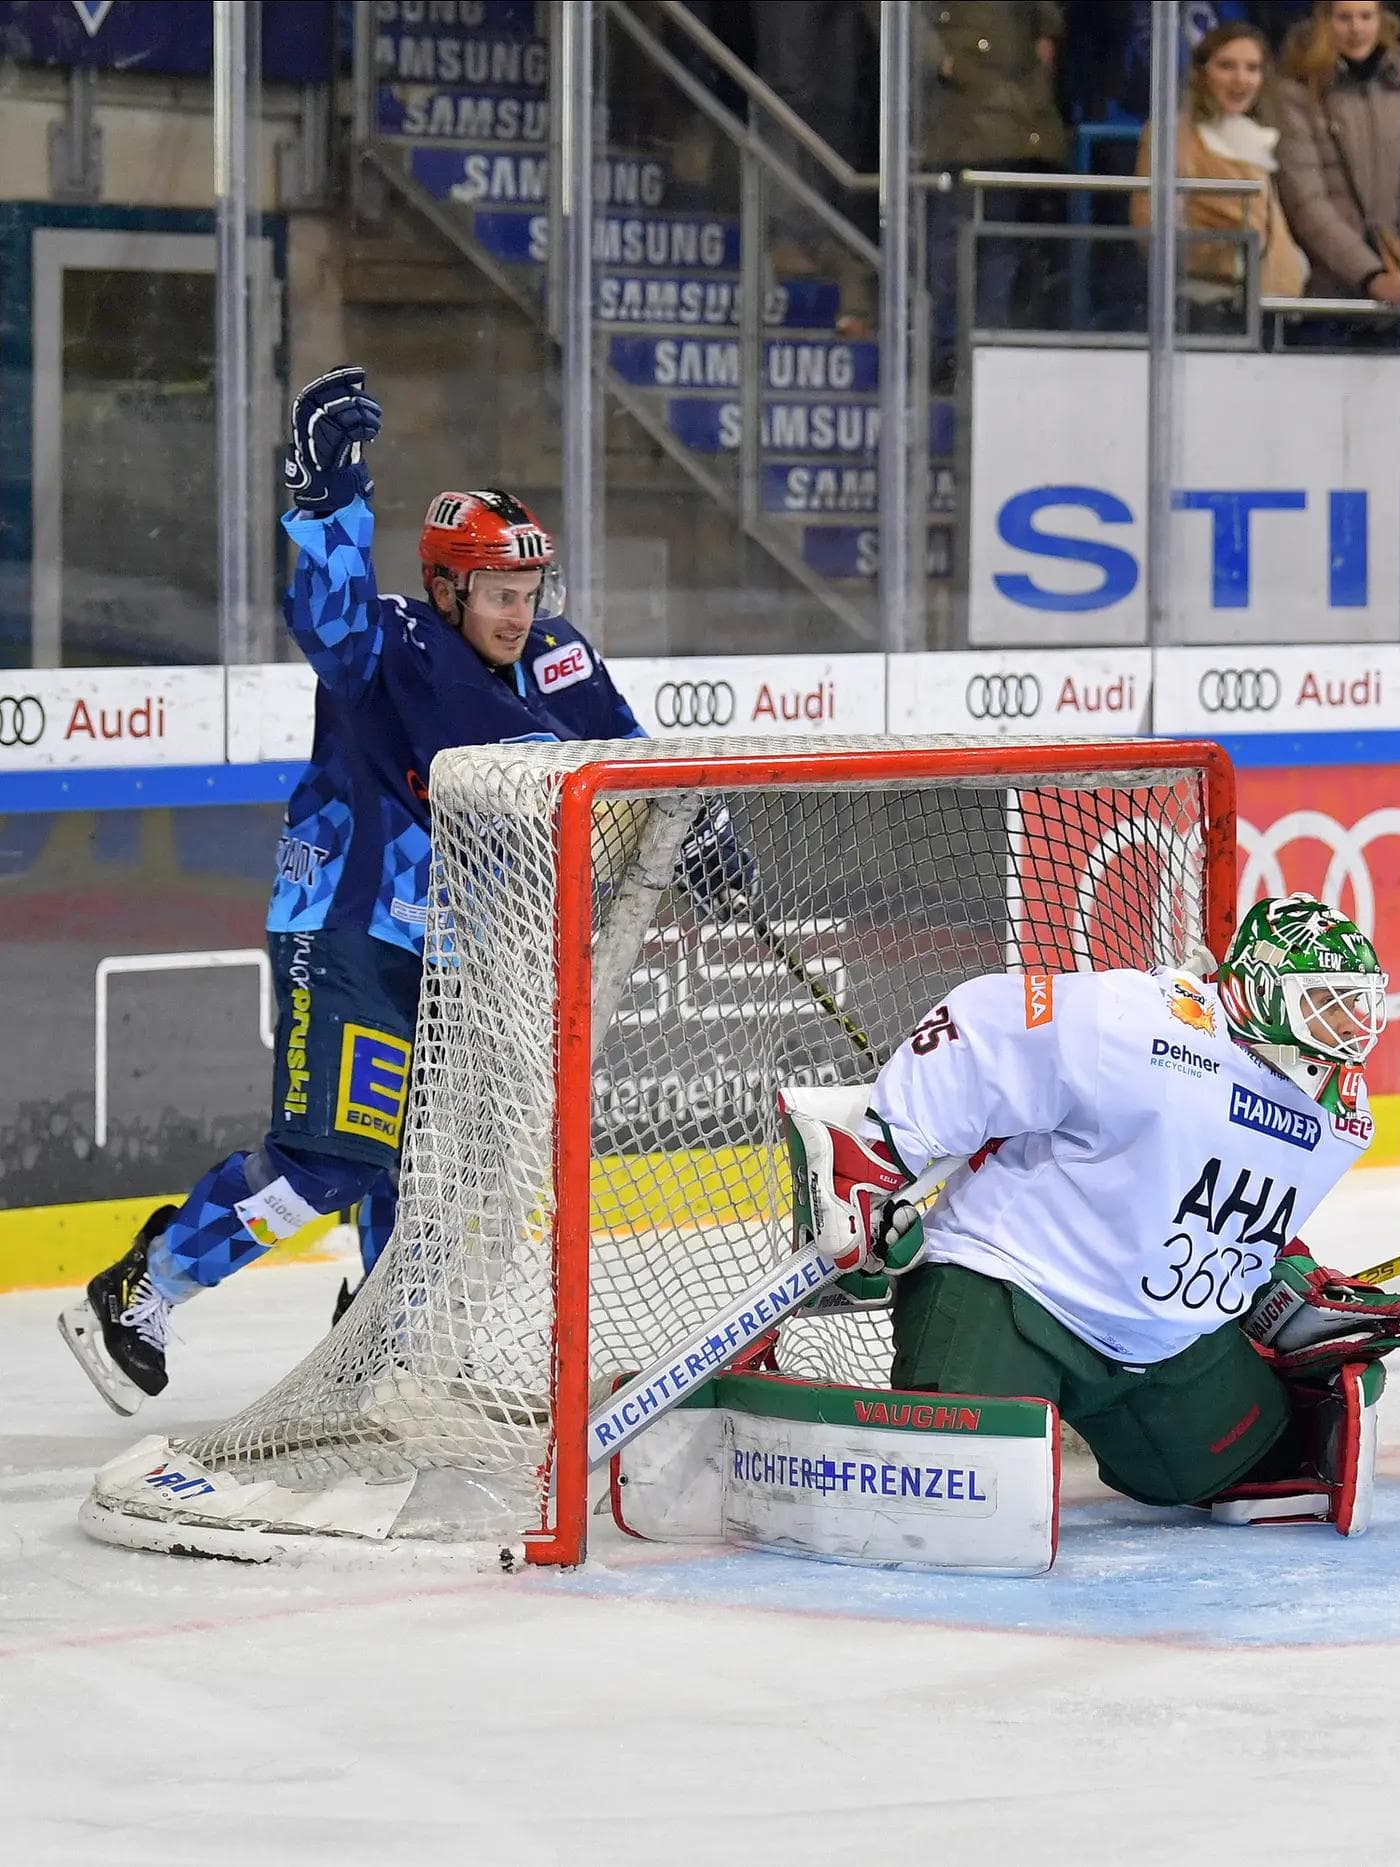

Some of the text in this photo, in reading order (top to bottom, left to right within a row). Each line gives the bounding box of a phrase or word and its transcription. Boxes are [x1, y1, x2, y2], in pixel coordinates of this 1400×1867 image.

[600, 279, 789, 324] SAMSUG
[654, 340, 854, 389] SAMUNG
[544, 649, 583, 685] DEL
[752, 681, 836, 722] Audi
[1056, 674, 1136, 713] Audi
[1296, 670, 1382, 707] Audi
[64, 697, 167, 740] Audi
[1318, 951, 1344, 971] LEW
[1030, 975, 1047, 1021] UKA
[1150, 1057, 1203, 1079] RECYCLING
[1151, 1038, 1221, 1075] Dehner
[1232, 1090, 1319, 1144] HAIMER
[1172, 1157, 1297, 1258] AHA
[594, 1255, 836, 1447] RICHTER FRENZEL
[854, 1400, 982, 1431] VAUGHN
[734, 1449, 986, 1501] RICHTER FRENZEL
